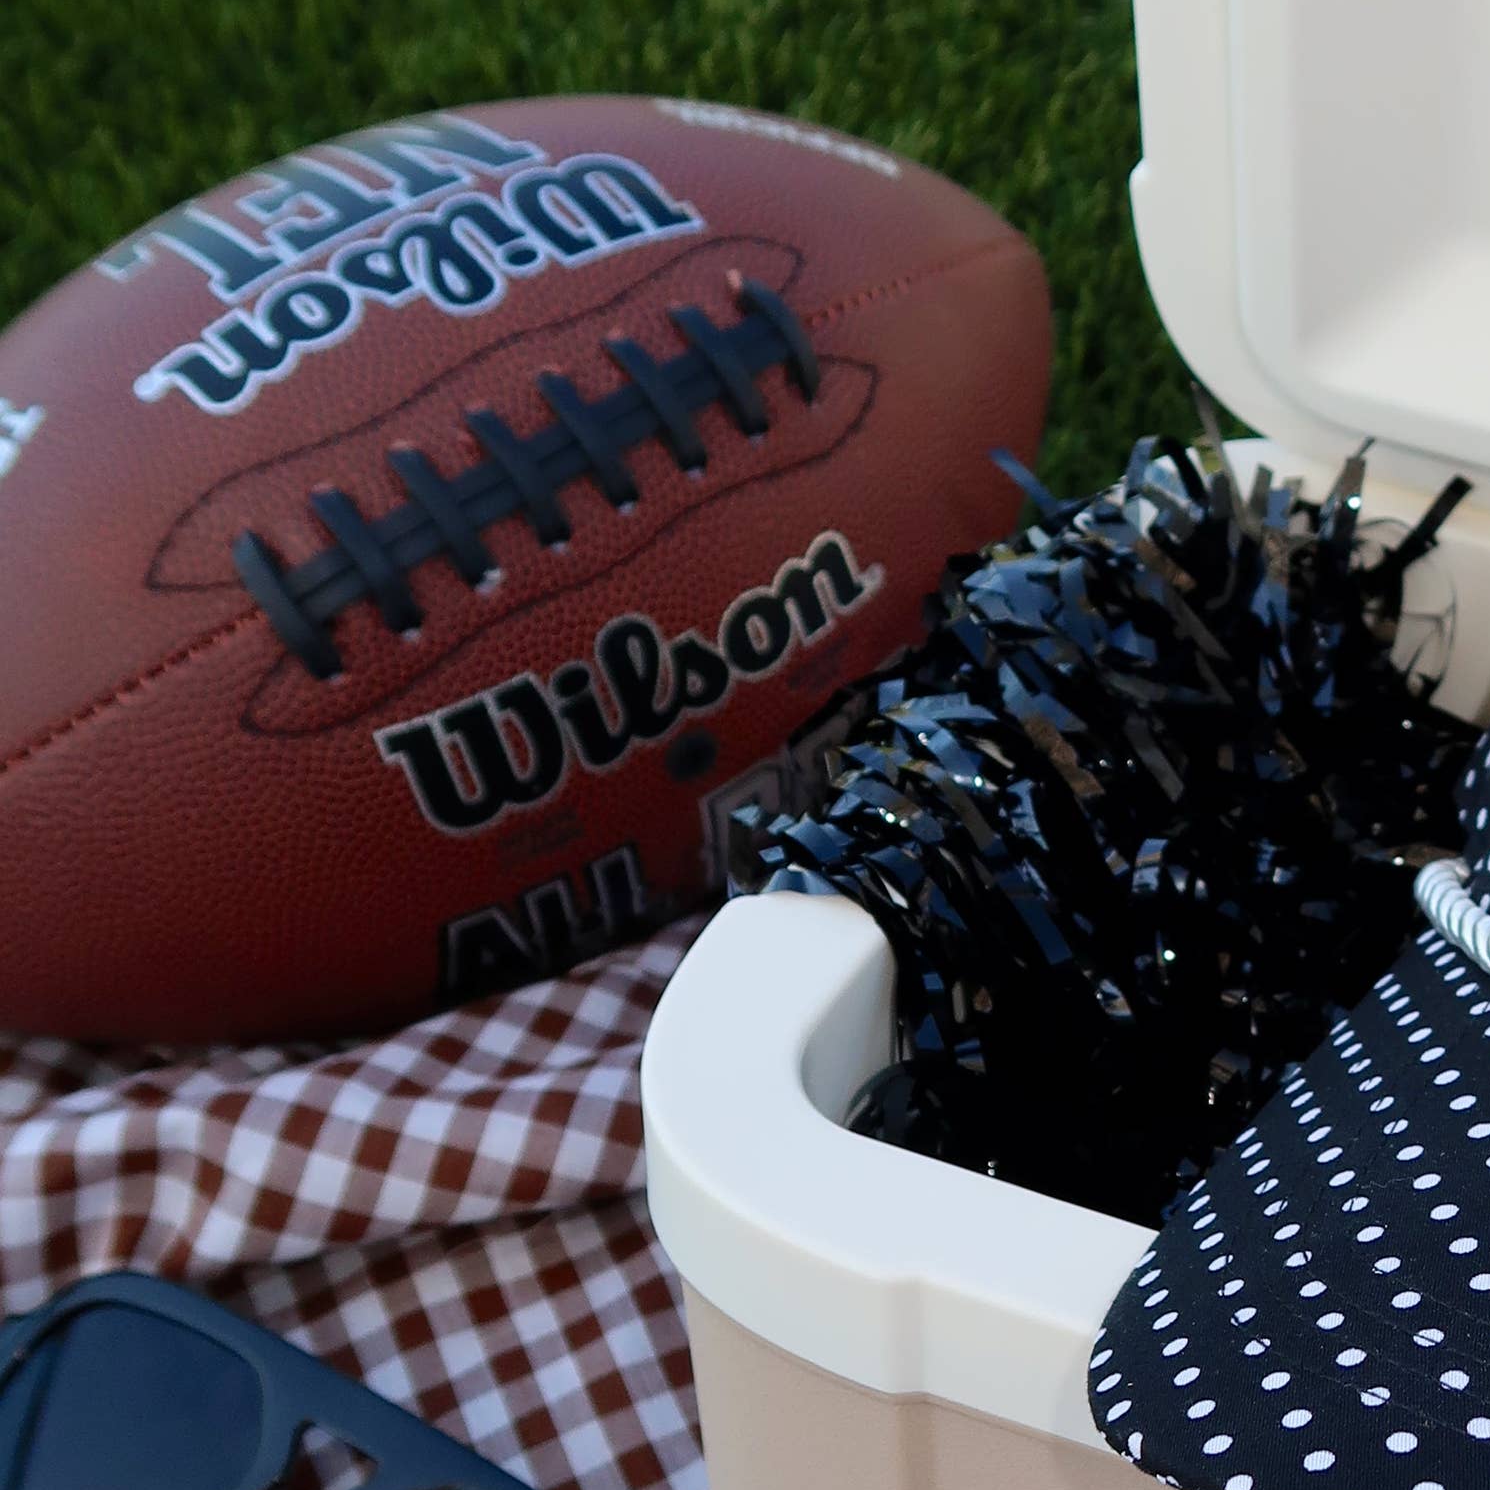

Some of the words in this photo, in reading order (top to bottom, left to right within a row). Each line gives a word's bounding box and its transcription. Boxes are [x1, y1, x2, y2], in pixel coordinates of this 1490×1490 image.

[92, 112, 546, 301] NFL
[134, 154, 704, 415] Wilson
[375, 531, 884, 836] Wilson
